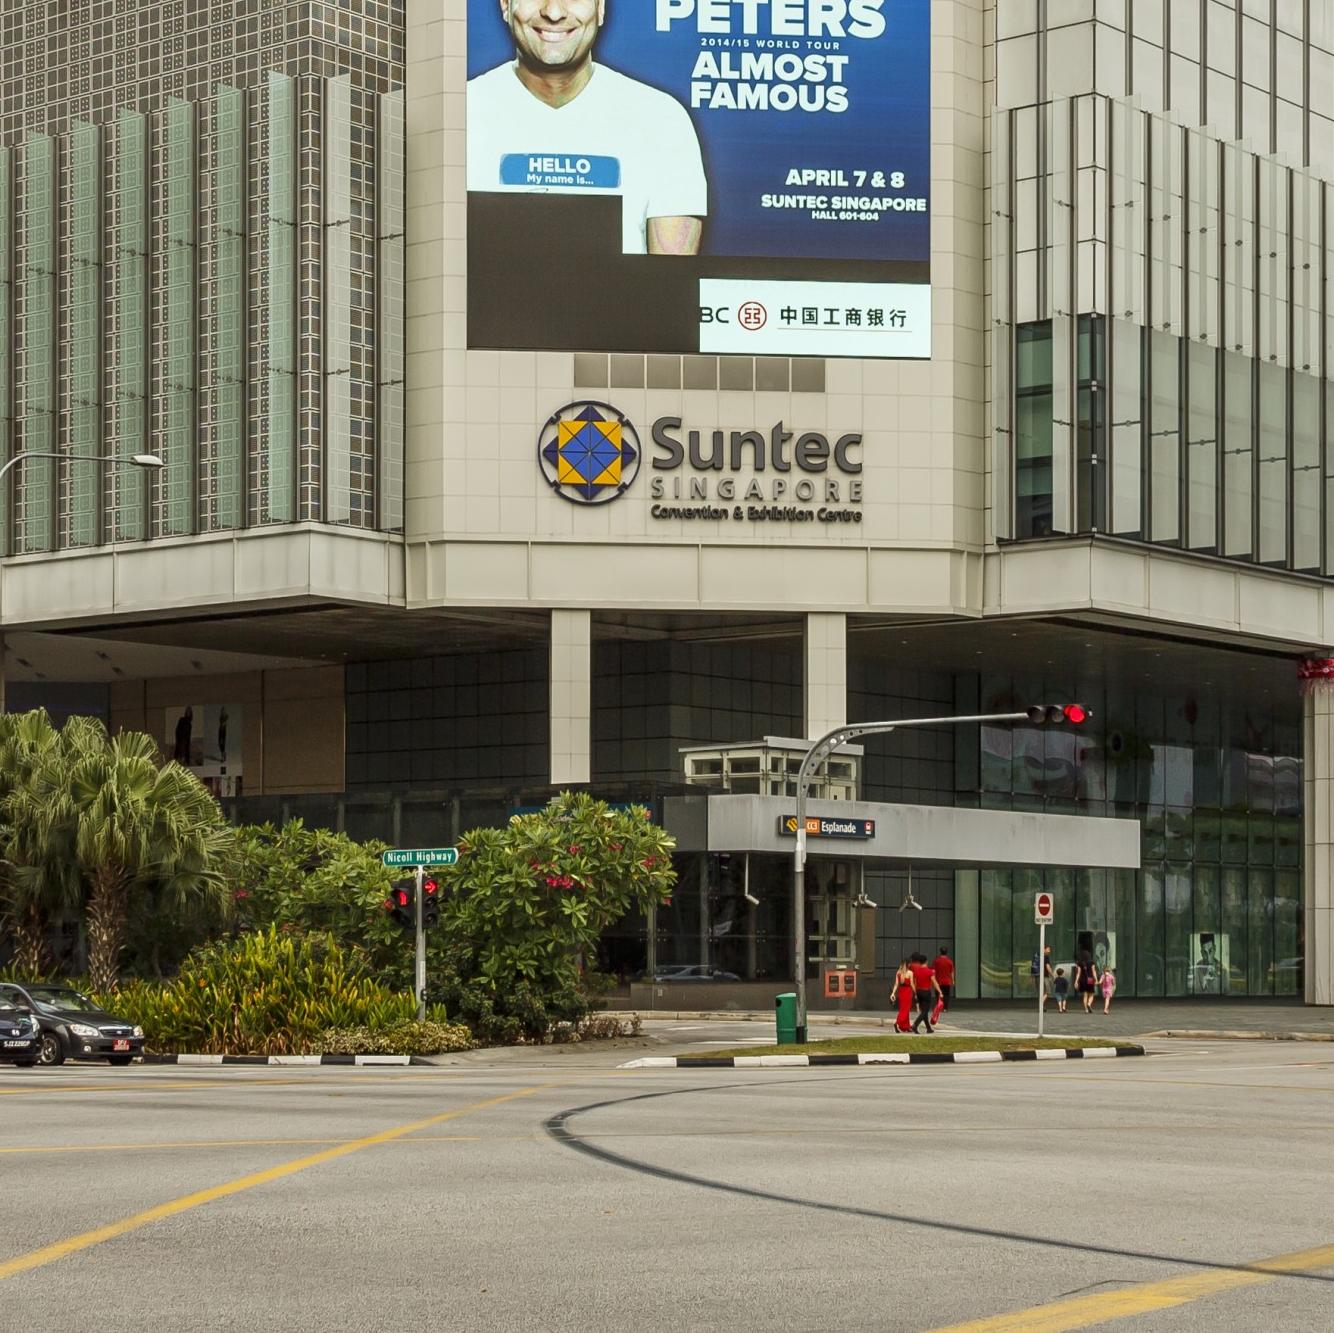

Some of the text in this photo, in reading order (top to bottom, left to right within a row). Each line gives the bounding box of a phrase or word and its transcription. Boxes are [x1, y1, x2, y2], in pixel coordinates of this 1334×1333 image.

[701, 37, 840, 50] 2014/15 WORLD TOUR
[691, 50, 849, 83] ALMOST
[690, 81, 849, 113] FAMOUS
[528, 157, 591, 174] HELLO
[527, 173, 594, 185] My name is...
[785, 168, 905, 189] APRIL 7 & 8
[761, 194, 927, 212] SUNTEC SINGAPORE
[812, 210, 879, 221] HALL 601-604
[780, 305, 907, 327] 中国工商银行
[651, 416, 863, 473] Suntec
[651, 476, 862, 501] SINGAPORE
[651, 504, 863, 523] Convention & Exhibition Centre
[807, 822, 818, 830] CC3
[821, 821, 856, 834] Esplanade
[387, 851, 453, 863] Nicoll Highway
